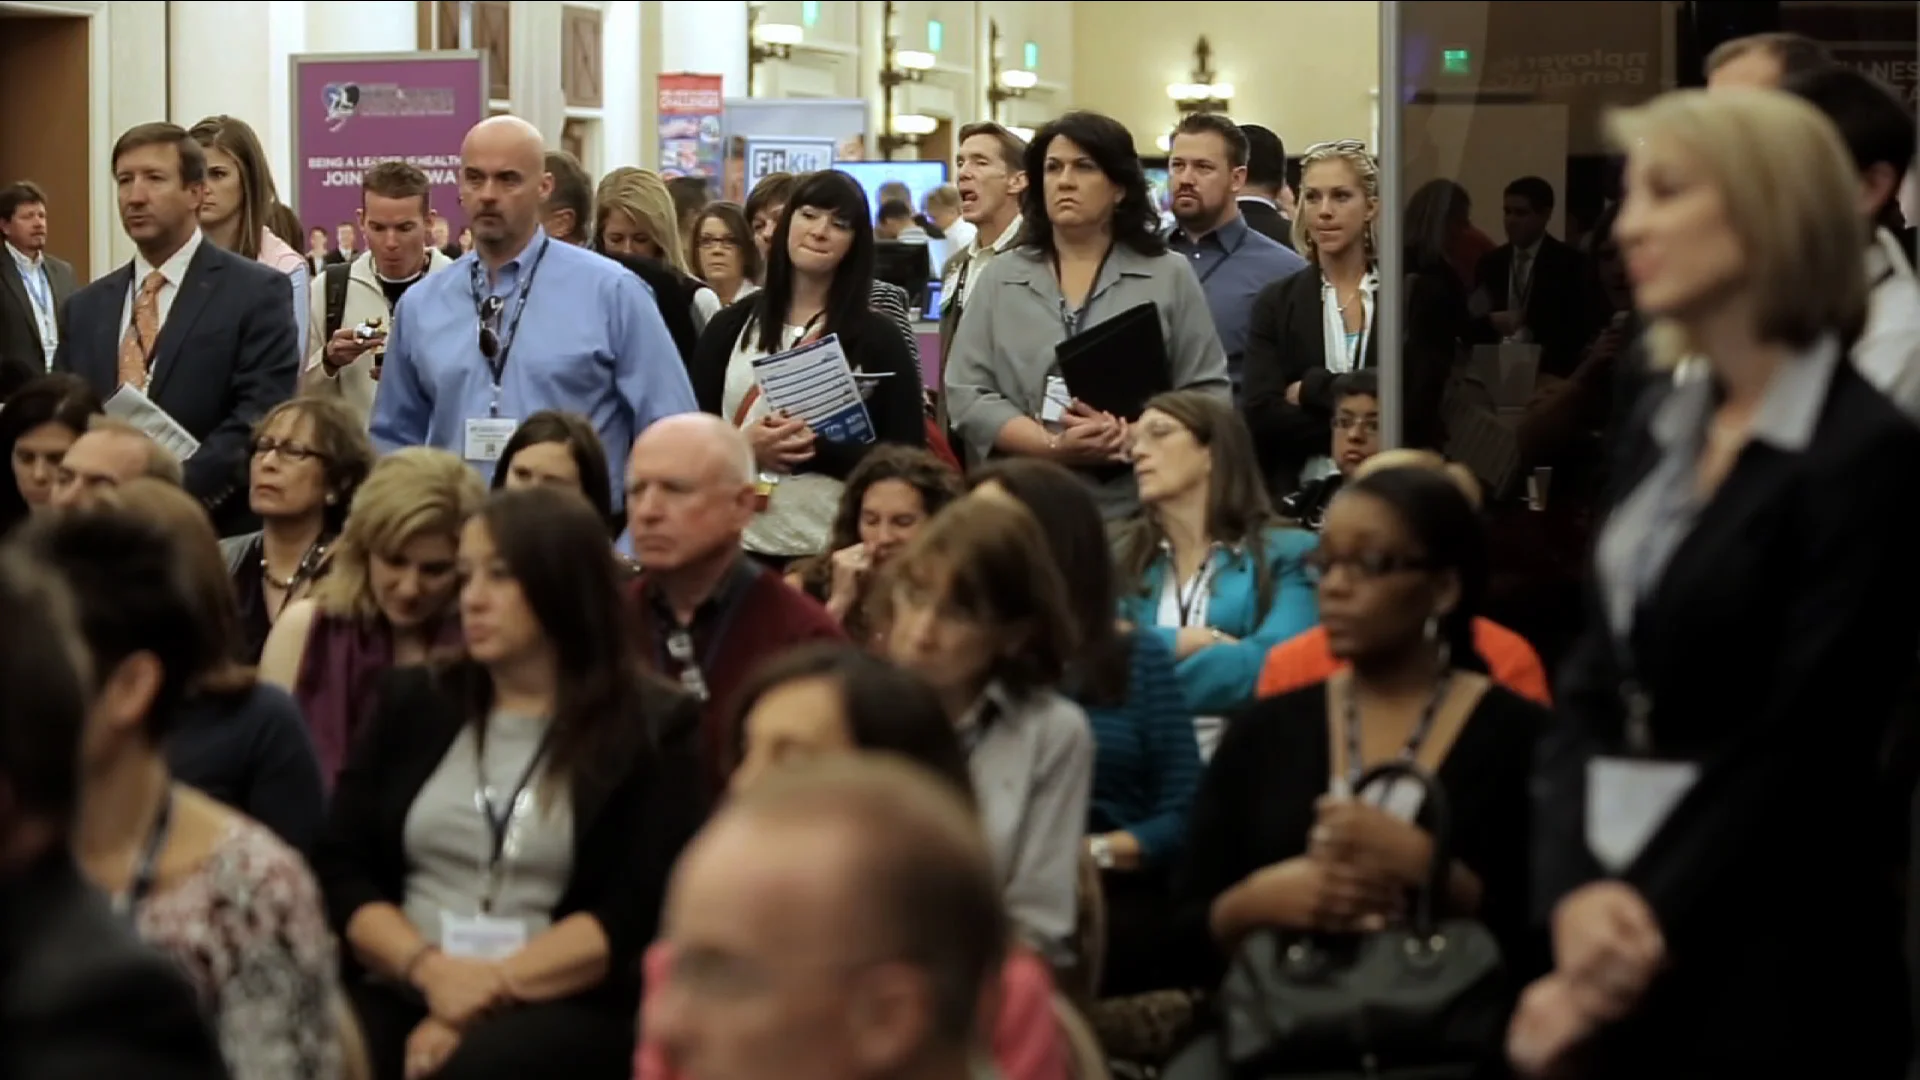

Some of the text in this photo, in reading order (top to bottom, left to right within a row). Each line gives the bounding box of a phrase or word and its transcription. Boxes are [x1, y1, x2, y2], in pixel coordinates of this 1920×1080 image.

[308, 157, 344, 168] BEING
[345, 156, 355, 168] A
[322, 170, 363, 186] JOIN
